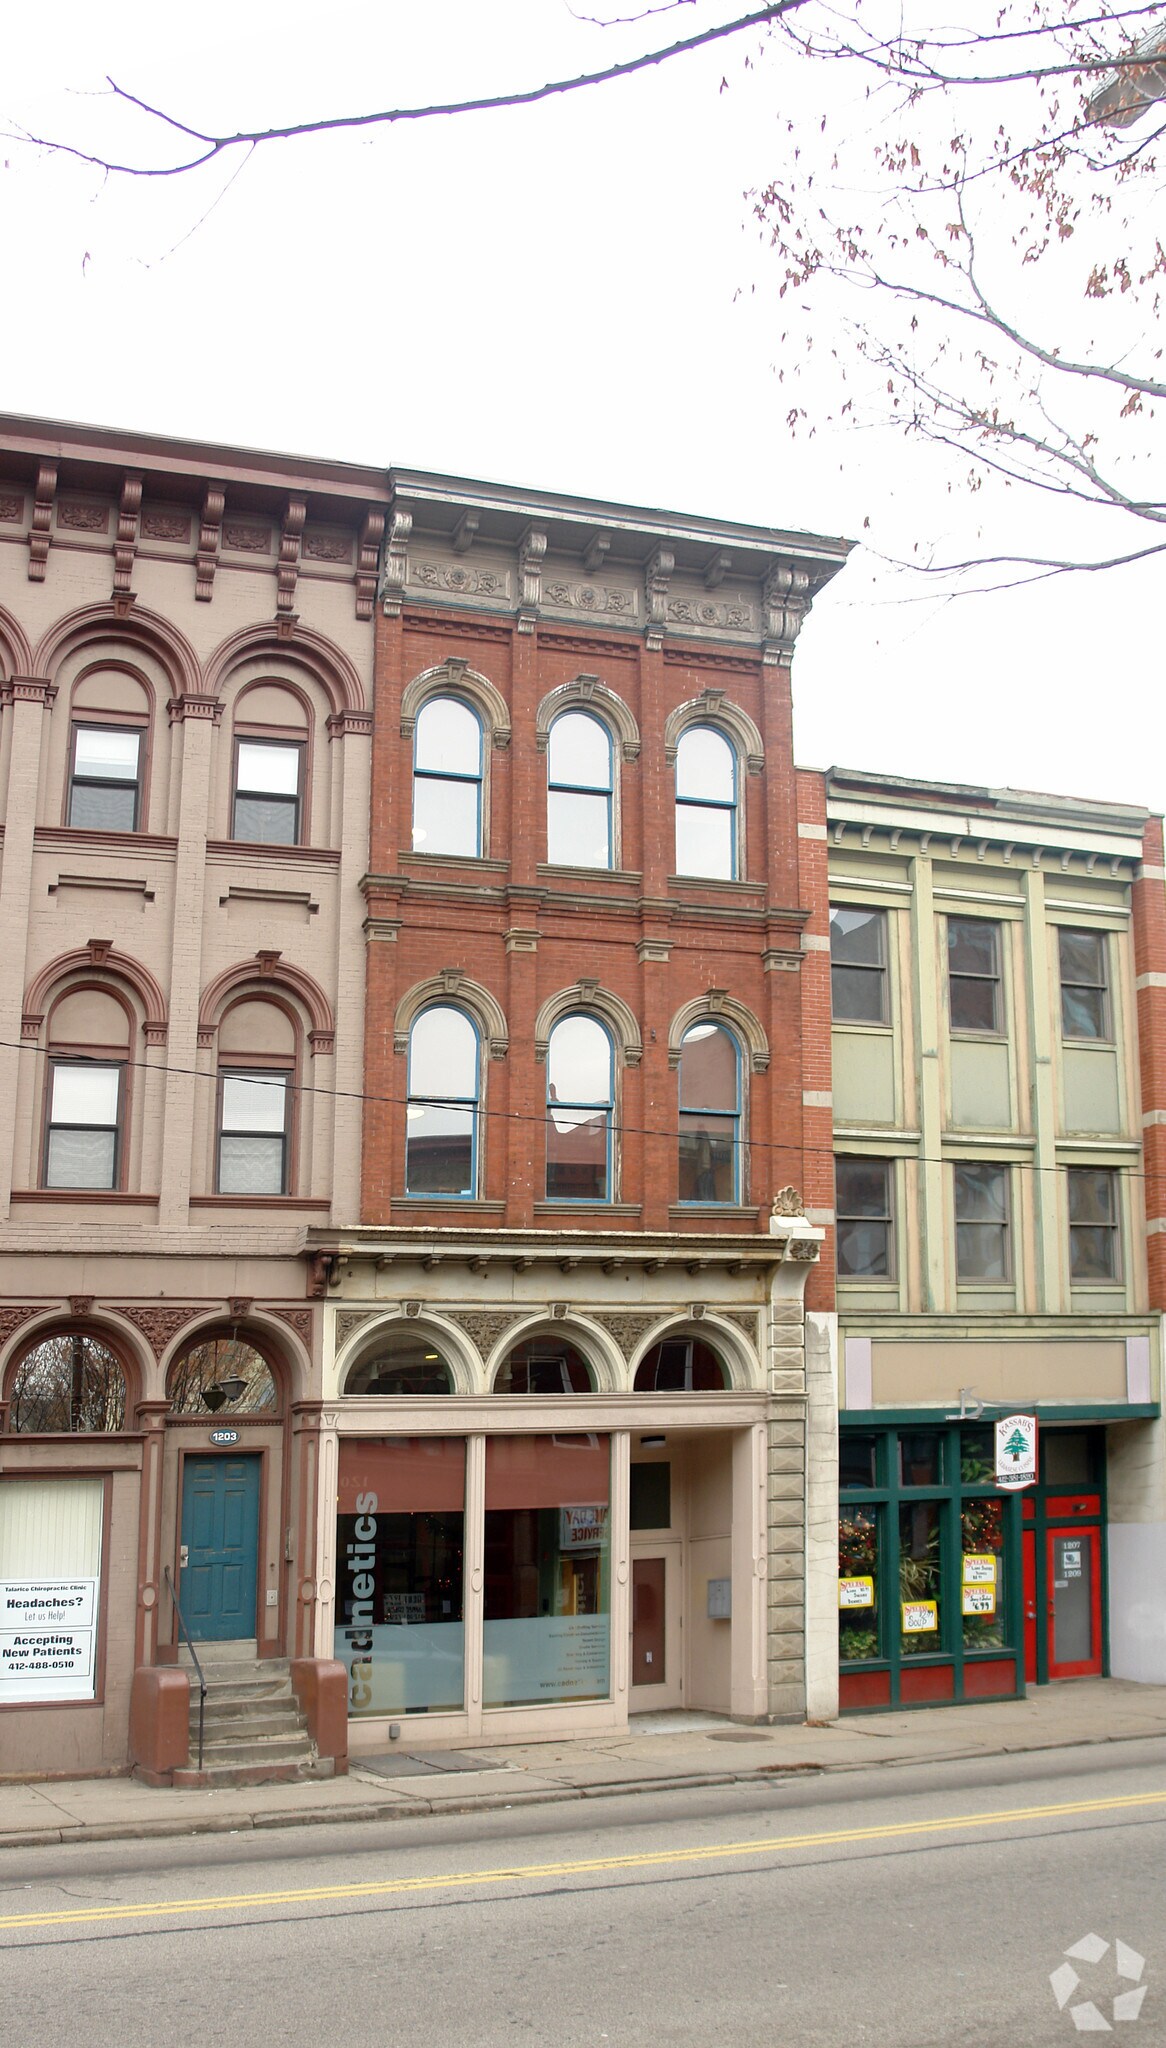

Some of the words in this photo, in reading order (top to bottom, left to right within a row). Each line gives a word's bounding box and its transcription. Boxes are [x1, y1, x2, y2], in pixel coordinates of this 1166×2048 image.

[212, 1432, 237, 1441] 1203
[1063, 1541, 1081, 1550] 1207
[6, 1597, 84, 1609] Headaches?
[345, 1491, 379, 1709] cadnetics
[24, 1611, 36, 1621] Let
[48, 1610, 66, 1621] Help!
[13, 1635, 74, 1646] Accepting
[2, 1648, 30, 1658] New
[33, 1646, 82, 1657] Patients
[8, 1660, 75, 1670] 412-488-0510
